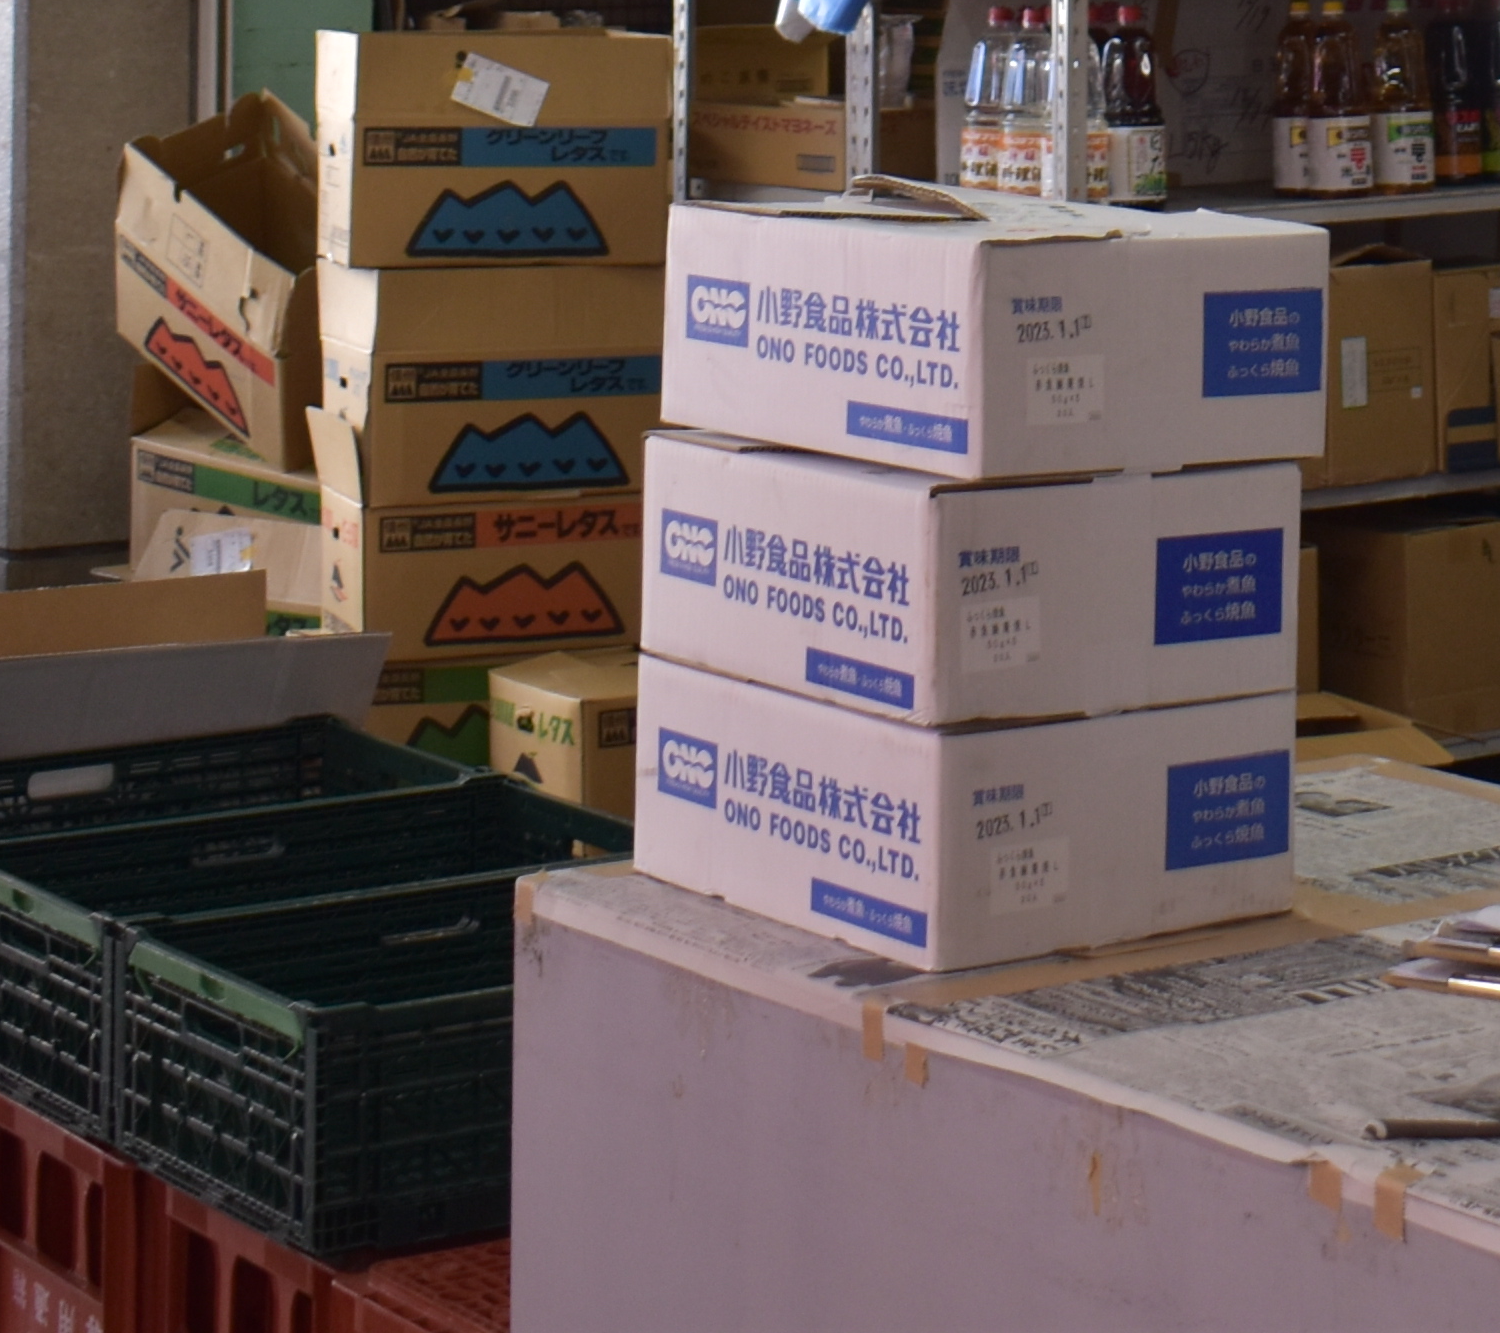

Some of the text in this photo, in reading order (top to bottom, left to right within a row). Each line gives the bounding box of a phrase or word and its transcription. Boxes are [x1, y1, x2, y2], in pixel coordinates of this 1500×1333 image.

[552, 146, 606, 161] レタス
[1012, 296, 1062, 314] 賞味期限
[757, 287, 960, 352] 小野食品株式会社
[1229, 306, 1300, 328] 小野食品の
[757, 335, 795, 363] ONO
[805, 343, 868, 375] FOODS
[1227, 358, 1300, 379] ふっくら焼魚
[571, 377, 624, 393] レタス
[493, 509, 617, 542] サニーレタス
[724, 523, 910, 608] 小野食品株式会社
[959, 548, 1020, 565] 賞味期限
[1183, 552, 1256, 573] 小野食品の
[723, 577, 759, 612] ONO
[767, 587, 825, 624] FOODS
[1180, 601, 1257, 623] ふっくら焼魚
[539, 712, 575, 747] レタス
[724, 748, 922, 845] 小野食品株式会社
[972, 784, 1024, 807] 賞味期限
[1193, 775, 1267, 797] 小野食品の
[724, 798, 762, 832] ONO
[769, 810, 831, 854] FOODS
[1190, 824, 1266, 848] ふっくら焼魚
